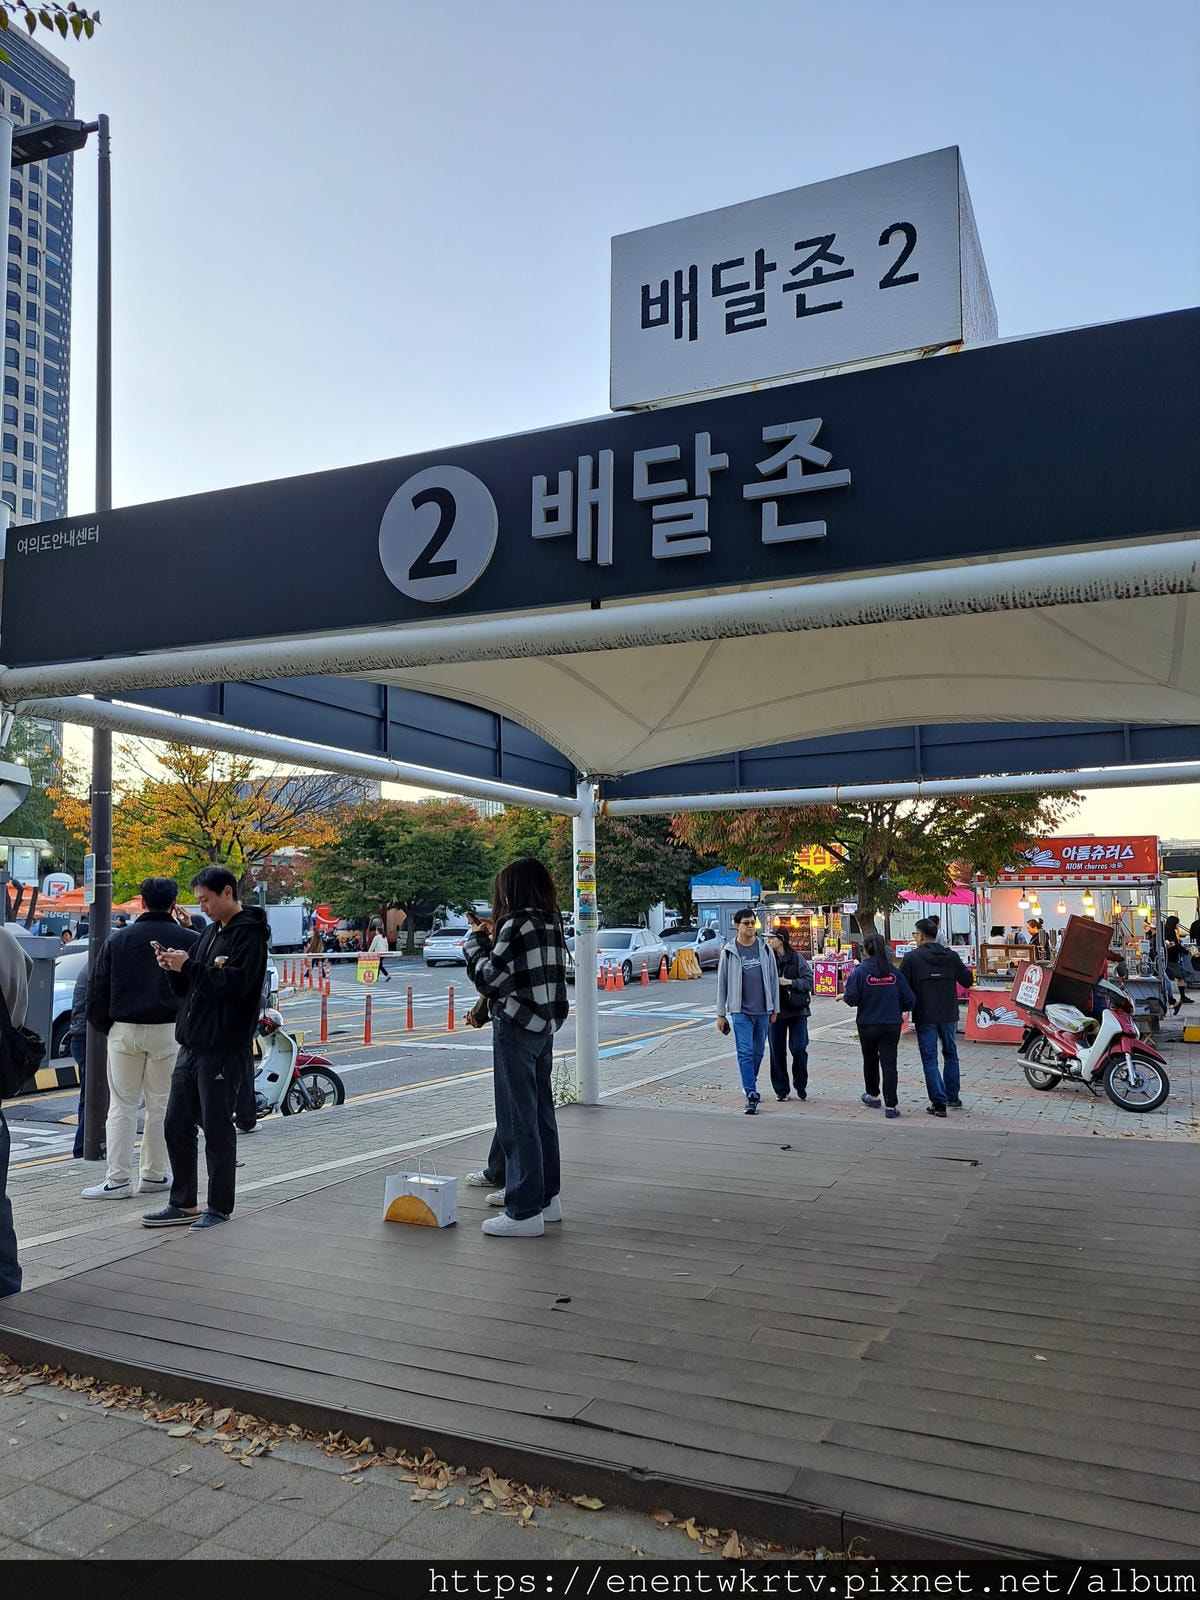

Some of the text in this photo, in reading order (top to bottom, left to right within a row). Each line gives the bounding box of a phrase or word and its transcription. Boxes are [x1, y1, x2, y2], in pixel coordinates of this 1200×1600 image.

[641, 221, 919, 341] 배달존 2
[408, 417, 851, 581] 2 배달존
[17, 525, 99, 555] 여의도안내센터
[1061, 844, 1135, 862] 아톰츄러스
[1065, 861, 1108, 871] ATOM churros
